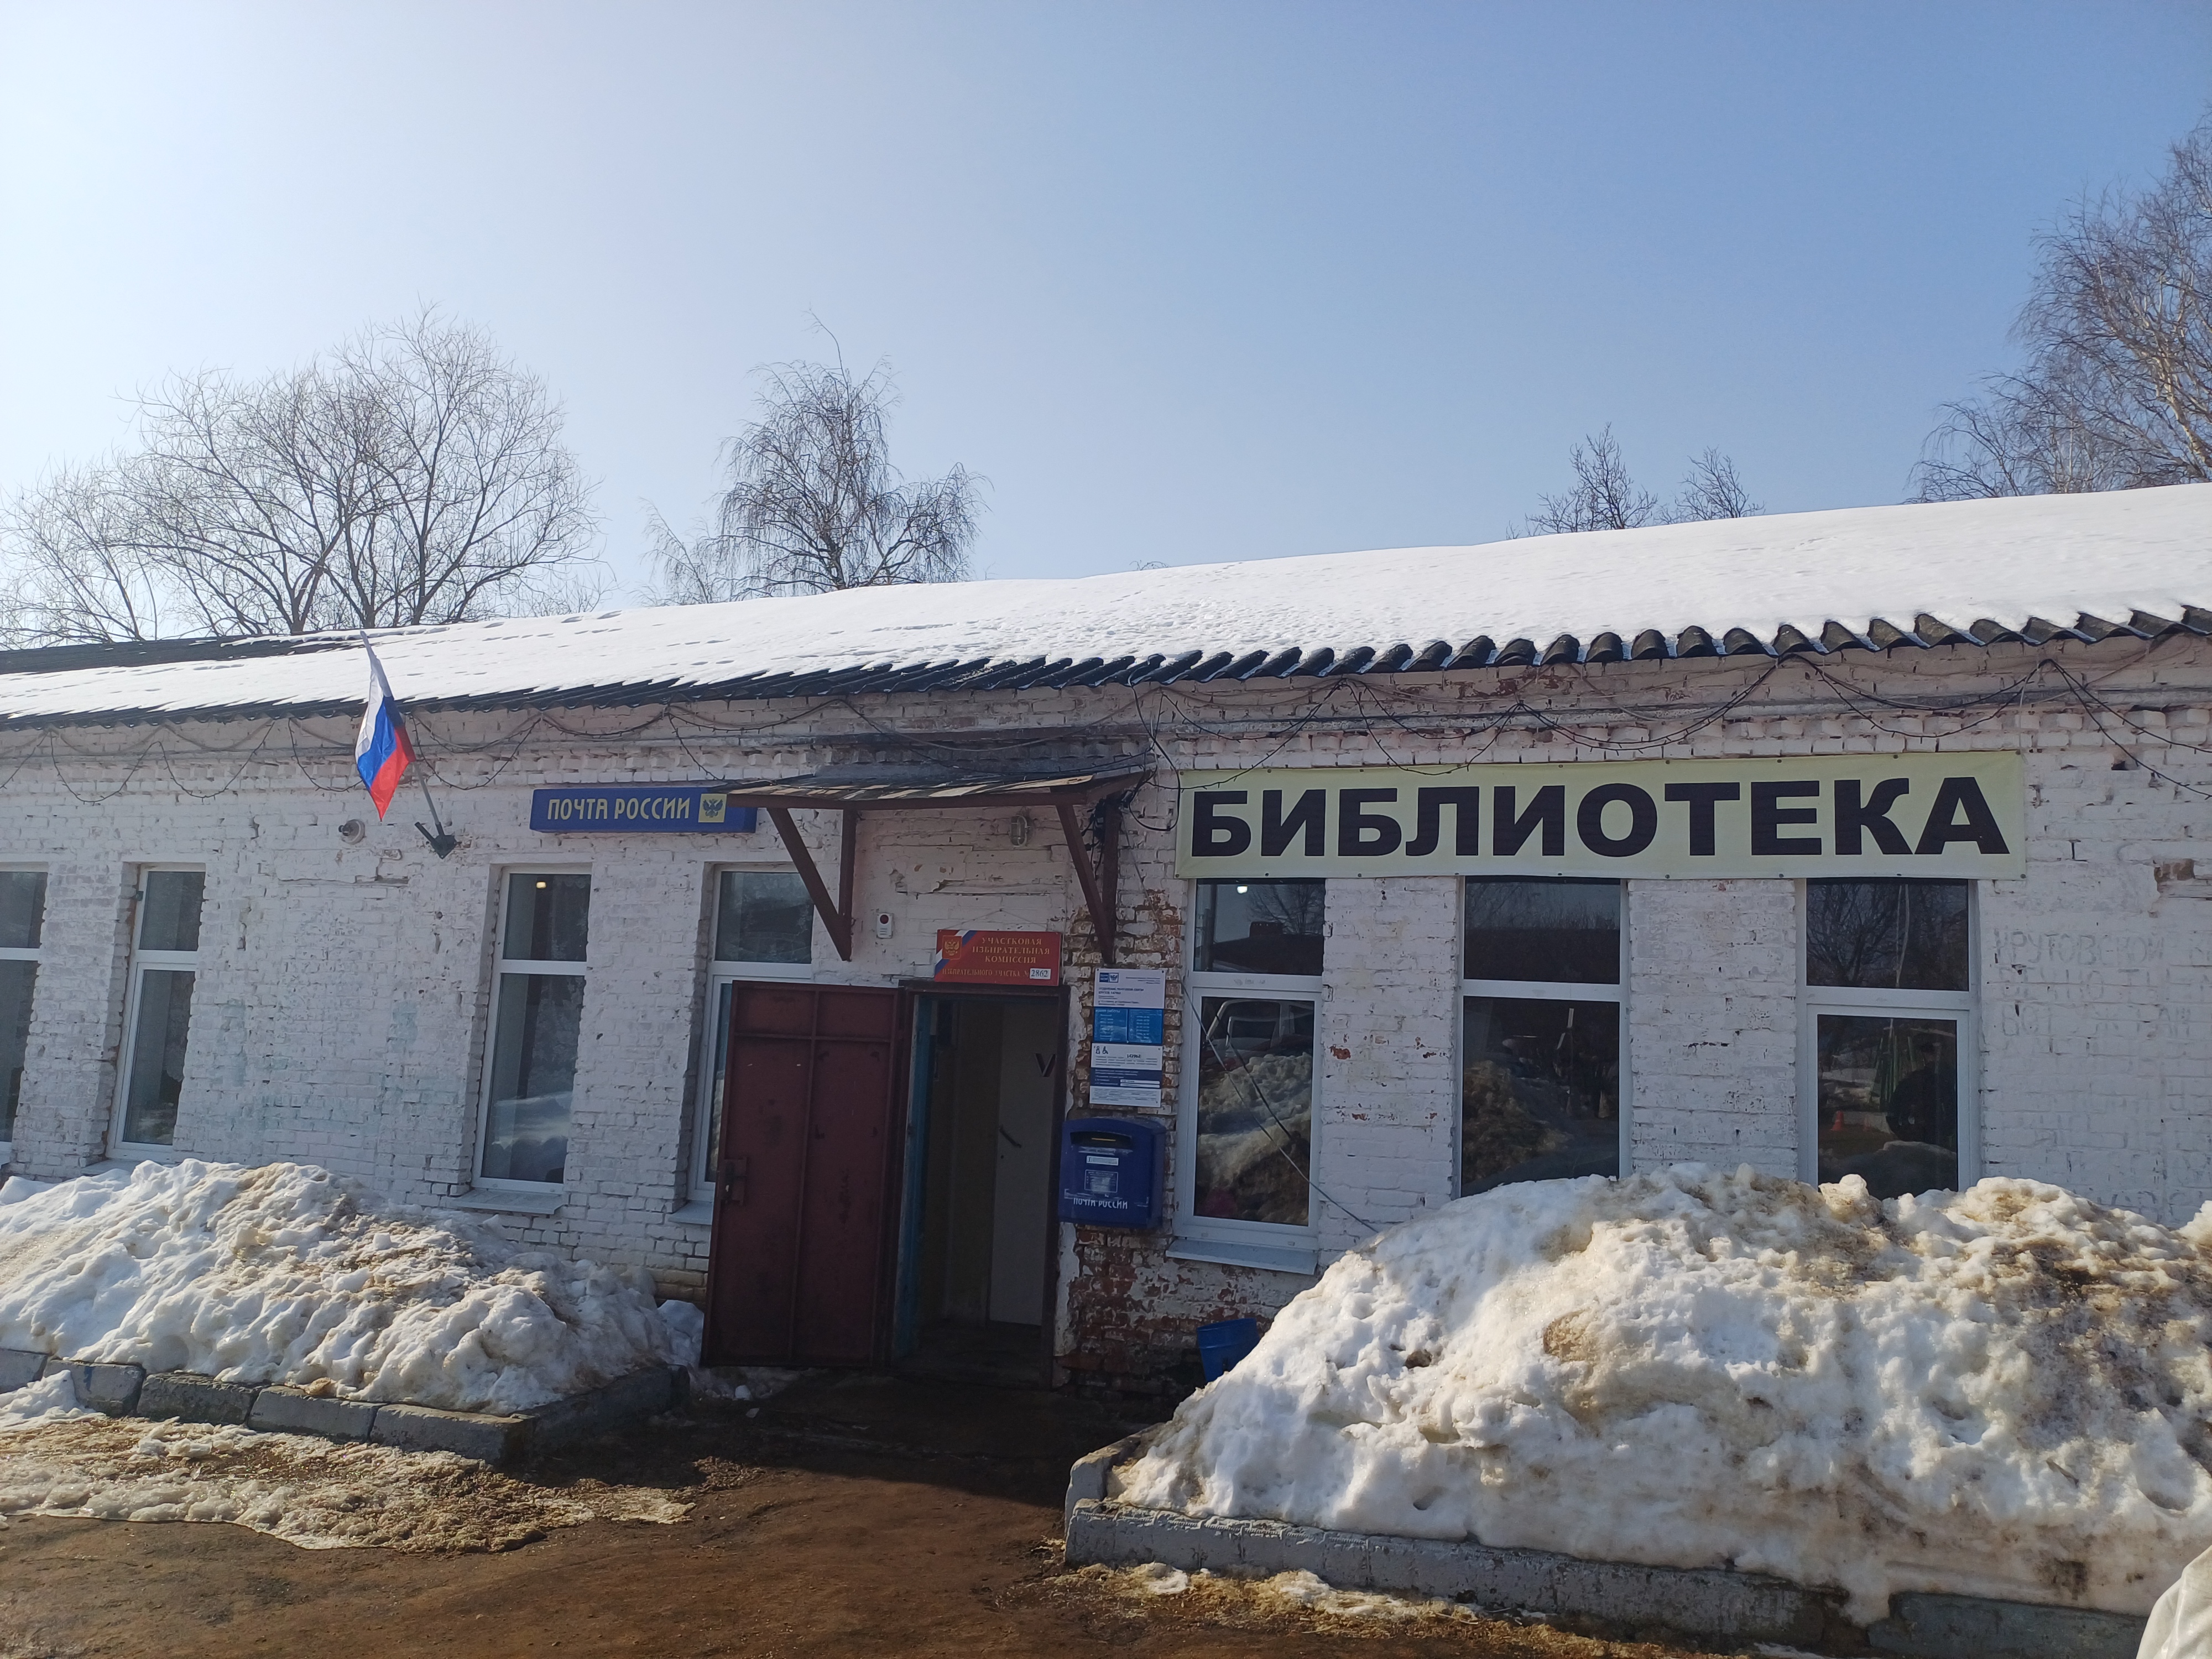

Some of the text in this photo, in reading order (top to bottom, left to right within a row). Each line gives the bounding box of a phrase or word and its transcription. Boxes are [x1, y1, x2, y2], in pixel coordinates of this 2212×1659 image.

[547, 797, 691, 820] ПОЧТА РОССИИ
[1191, 776, 2010, 858] БИБЛИОТЕКА
[982, 937, 1042, 945] УЧАСТКОВАЯ
[972, 946, 1050, 954] ИЗБИРАТЕЛЬНАЯ
[985, 955, 1036, 963] КОМИССИЯ
[942, 968, 993, 976] ИЗБИРАТЕЛЬНОГО
[1073, 1197, 1128, 1209] ПОЧТА РОССИИ
